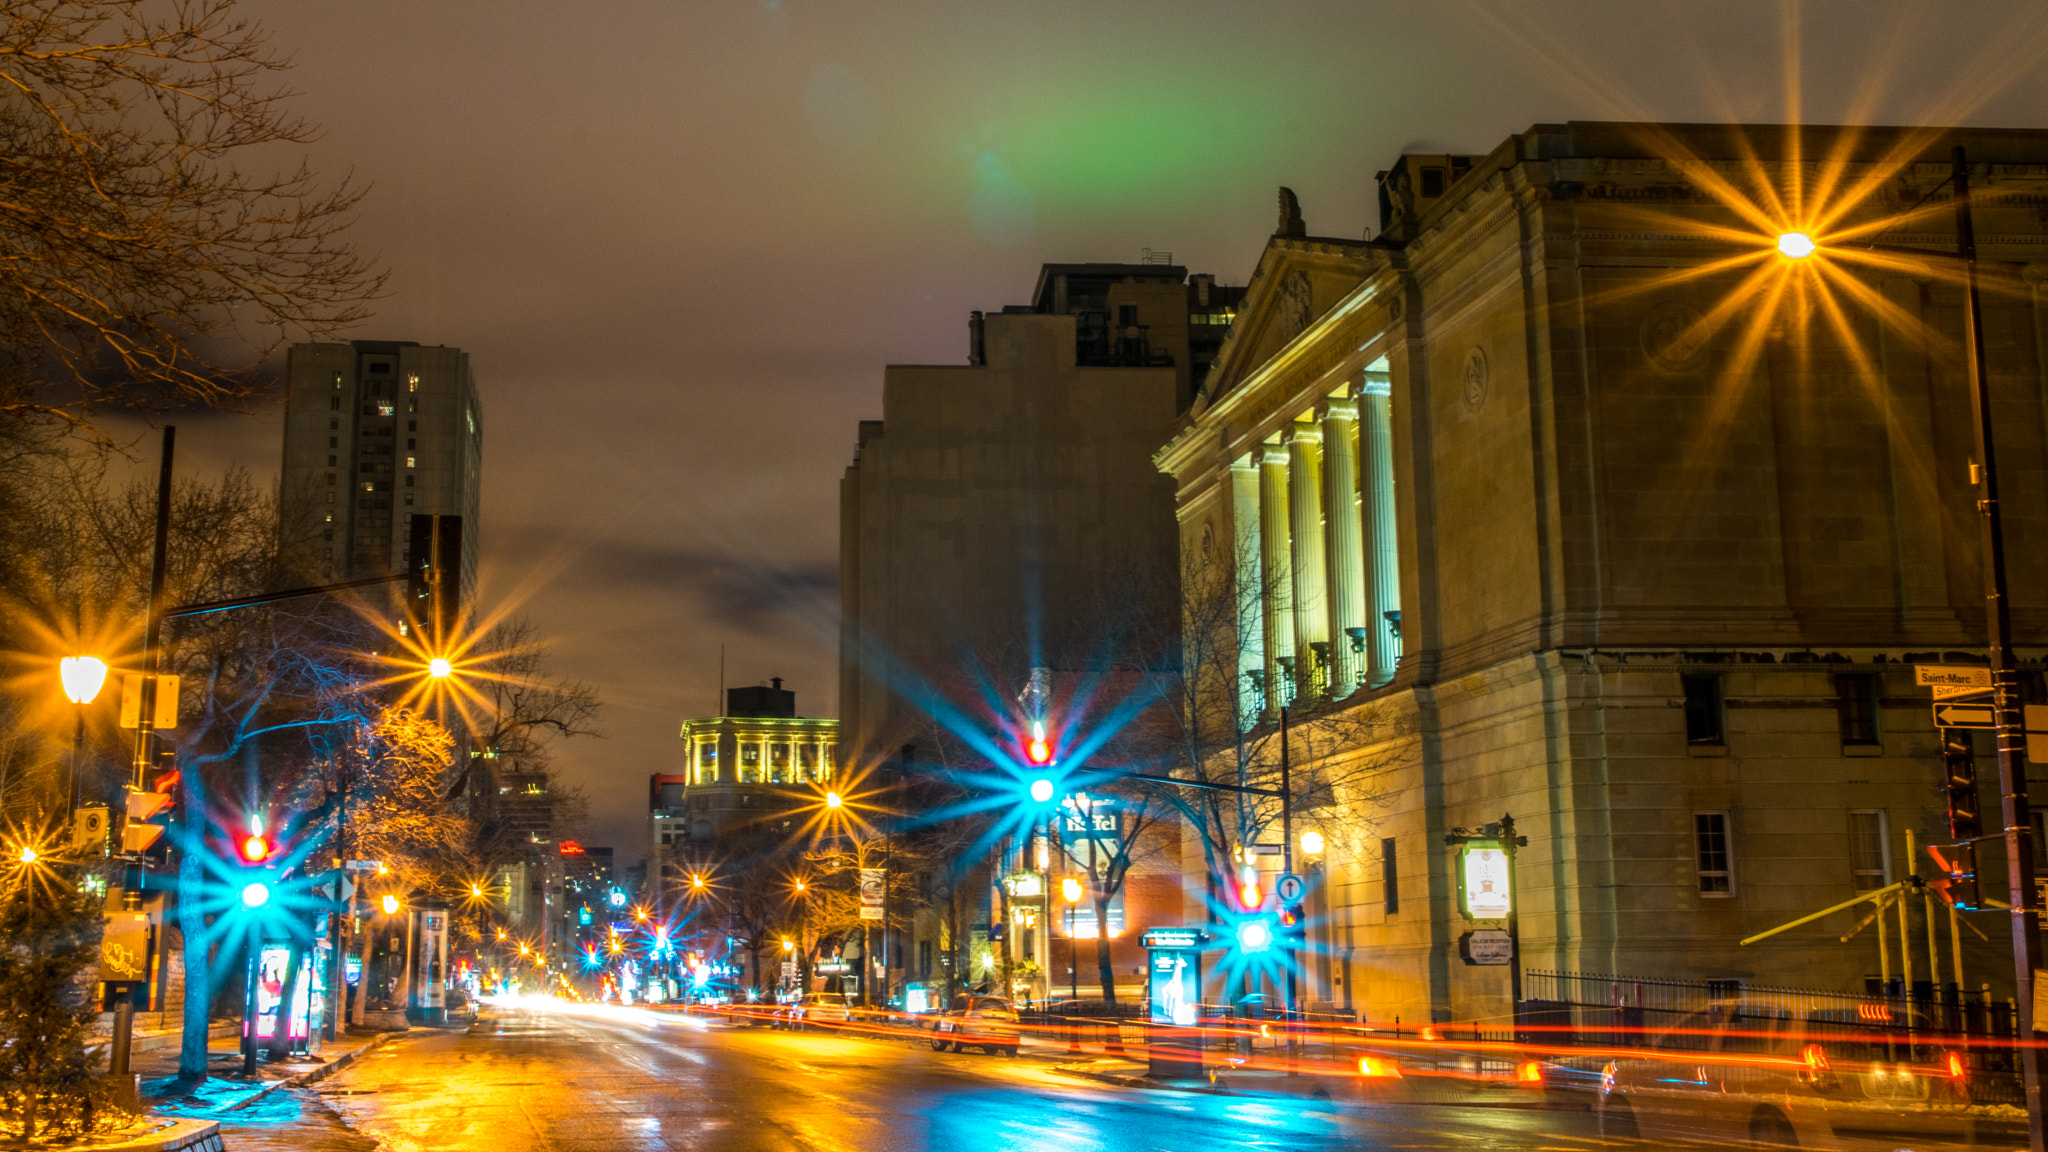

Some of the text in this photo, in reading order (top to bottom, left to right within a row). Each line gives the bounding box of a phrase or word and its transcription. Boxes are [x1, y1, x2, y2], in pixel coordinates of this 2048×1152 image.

[1921, 673, 1971, 684] Saint-Marc
[1937, 686, 1979, 696] Sherbroo
[2037, 890, 2045, 898] 24
